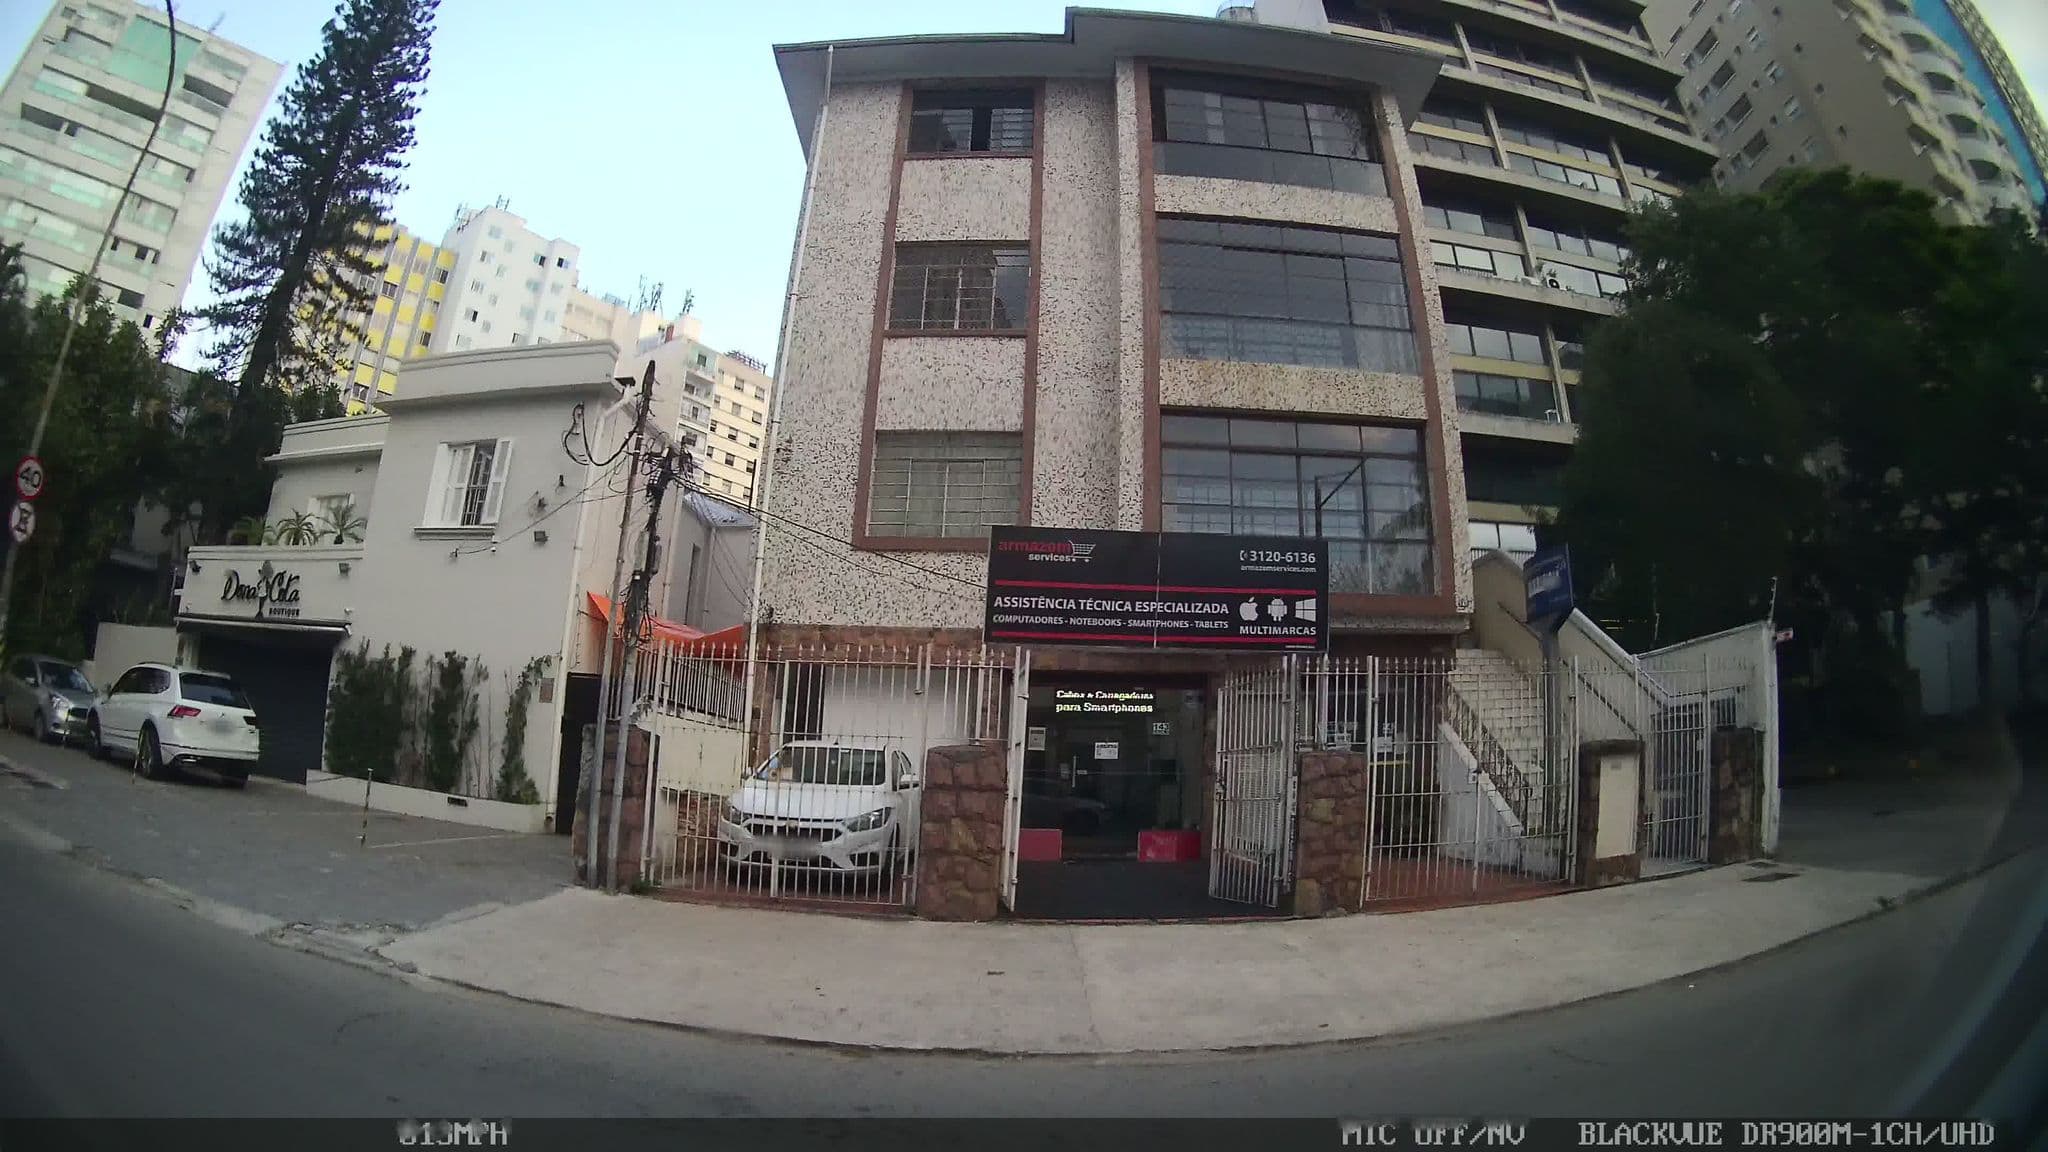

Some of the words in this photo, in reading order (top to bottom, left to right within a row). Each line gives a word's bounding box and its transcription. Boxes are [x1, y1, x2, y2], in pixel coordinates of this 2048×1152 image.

[20, 466, 41, 488] 40
[1028, 553, 1071, 562] services
[1250, 550, 1316, 564] 3120-6136
[993, 595, 1077, 610] ASSISTÊNCIA
[1078, 597, 1132, 612] TÉCNICA
[1135, 601, 1229, 614] ESPECIALIZADA
[992, 614, 1064, 625] COMPUTADORES
[1069, 617, 1122, 627] NOTEBOOKS
[1127, 619, 1189, 628] SMARTPHONES
[1194, 620, 1229, 629] TABLETS
[1239, 626, 1317, 635] MULTIMARCAS
[1055, 704, 1082, 713] para
[1083, 702, 1154, 714] Smartphones
